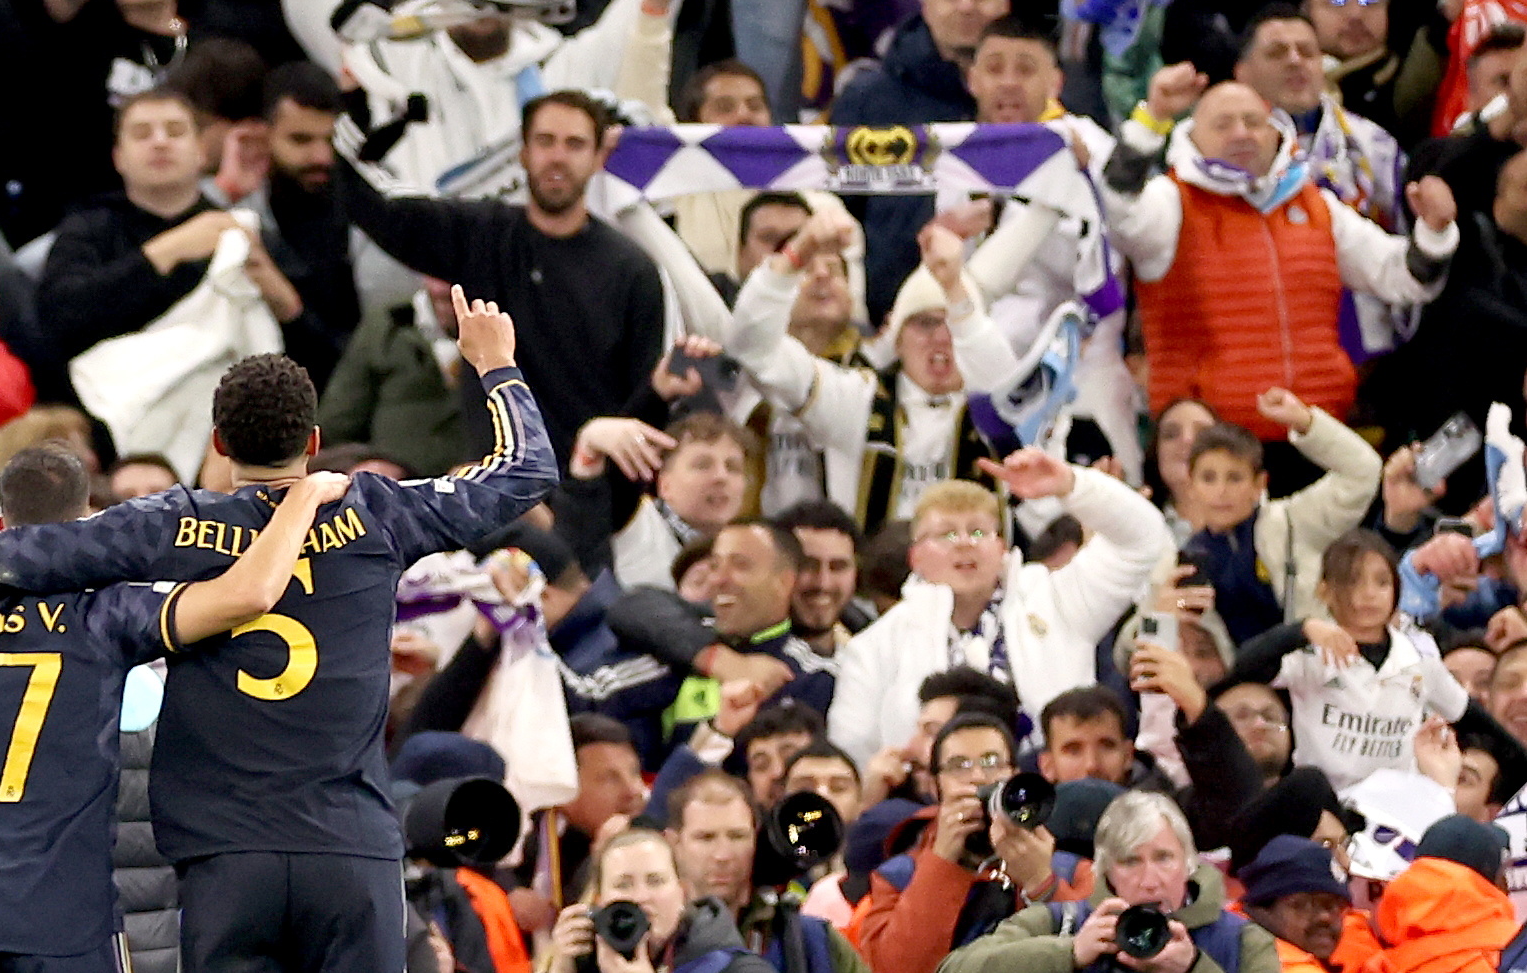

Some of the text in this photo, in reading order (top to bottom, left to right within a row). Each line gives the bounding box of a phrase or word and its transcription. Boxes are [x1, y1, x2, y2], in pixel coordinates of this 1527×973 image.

[174, 507, 367, 557] BELLHAM
[37, 602, 67, 634] V.
[231, 557, 318, 701] 5
